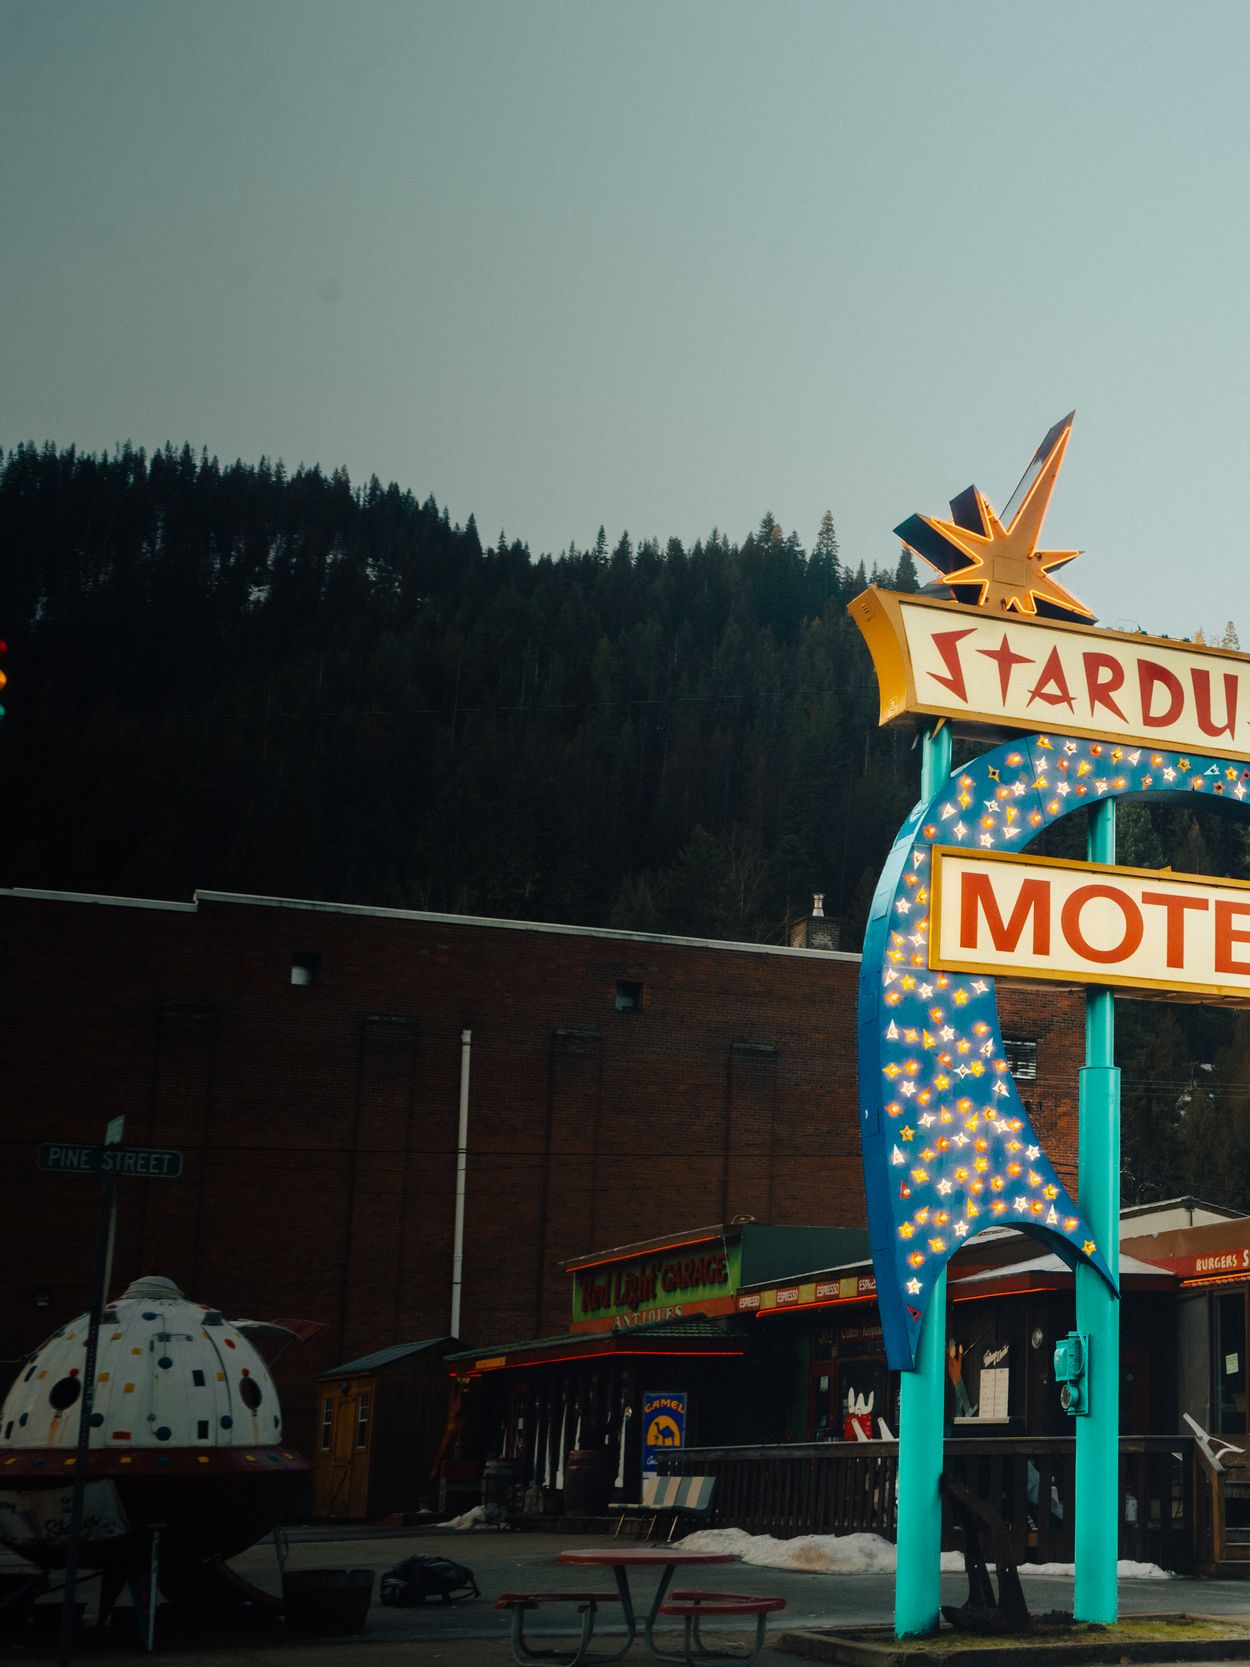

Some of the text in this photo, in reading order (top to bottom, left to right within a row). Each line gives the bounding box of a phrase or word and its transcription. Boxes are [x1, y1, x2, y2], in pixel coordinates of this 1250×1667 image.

[47, 1147, 173, 1174] PINE STREET
[1195, 1254, 1238, 1272] BURGERS
[661, 1255, 728, 1293] GARAGE
[777, 1289, 799, 1303] ESPRESSO
[816, 1283, 839, 1297] ESPRESSO
[739, 1295, 761, 1309] ESPRESSO
[643, 1398, 685, 1414] CAMEL
